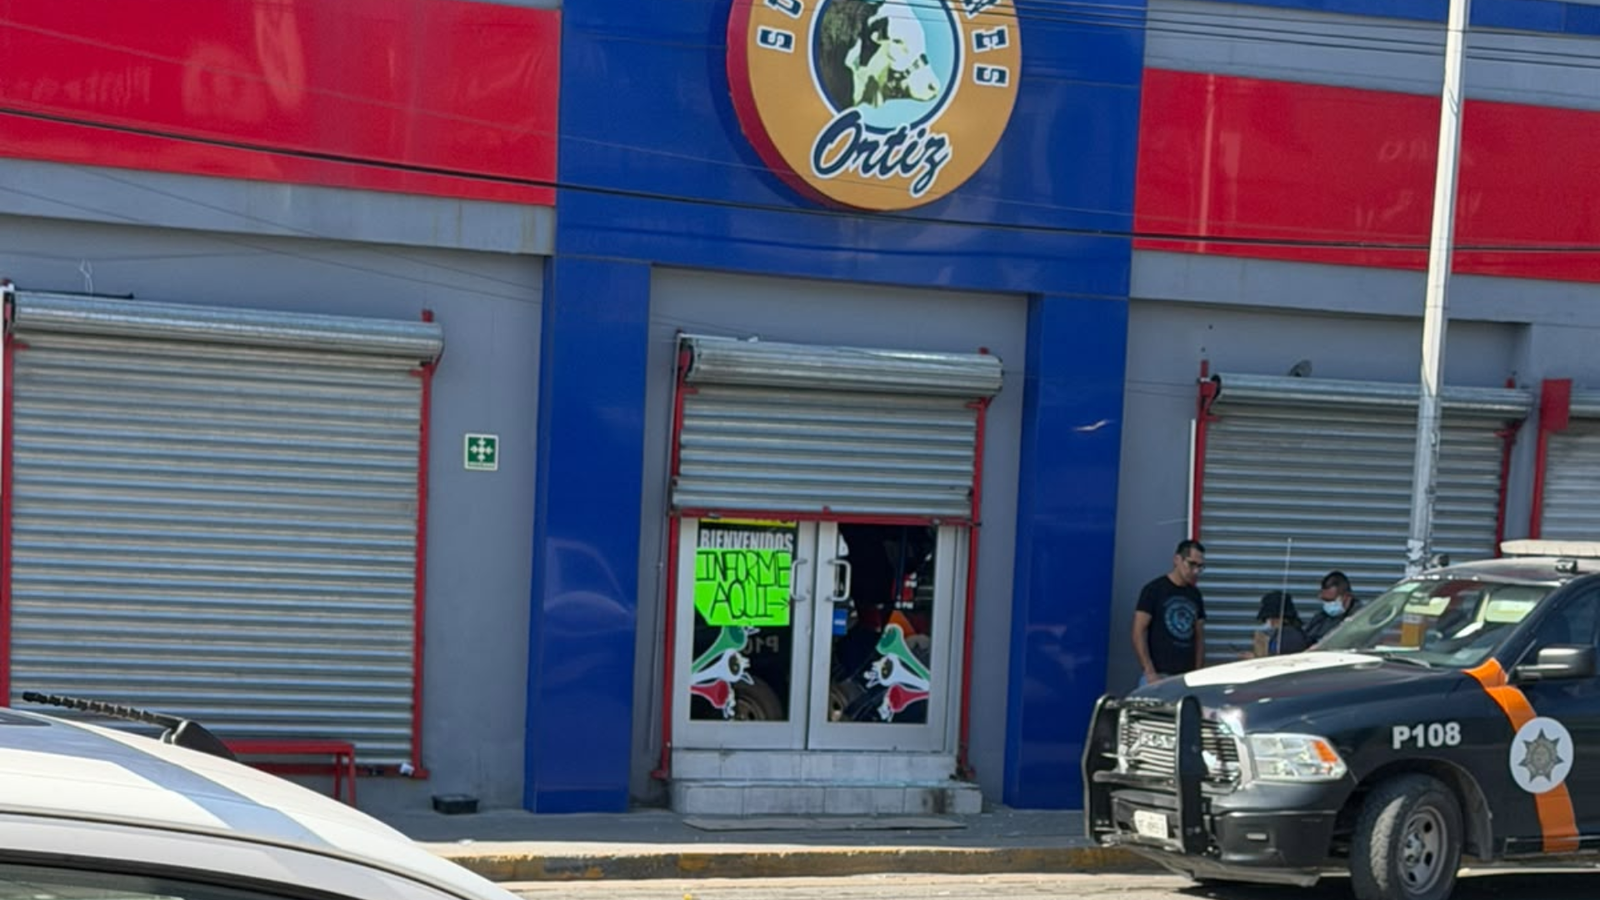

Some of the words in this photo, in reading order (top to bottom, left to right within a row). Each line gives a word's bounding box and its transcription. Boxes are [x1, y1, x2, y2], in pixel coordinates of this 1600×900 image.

[812, 108, 951, 196] Ortiz
[699, 529, 794, 552] BIENVENIDOS
[696, 550, 791, 588] INFORME
[1392, 721, 1461, 750] P108
